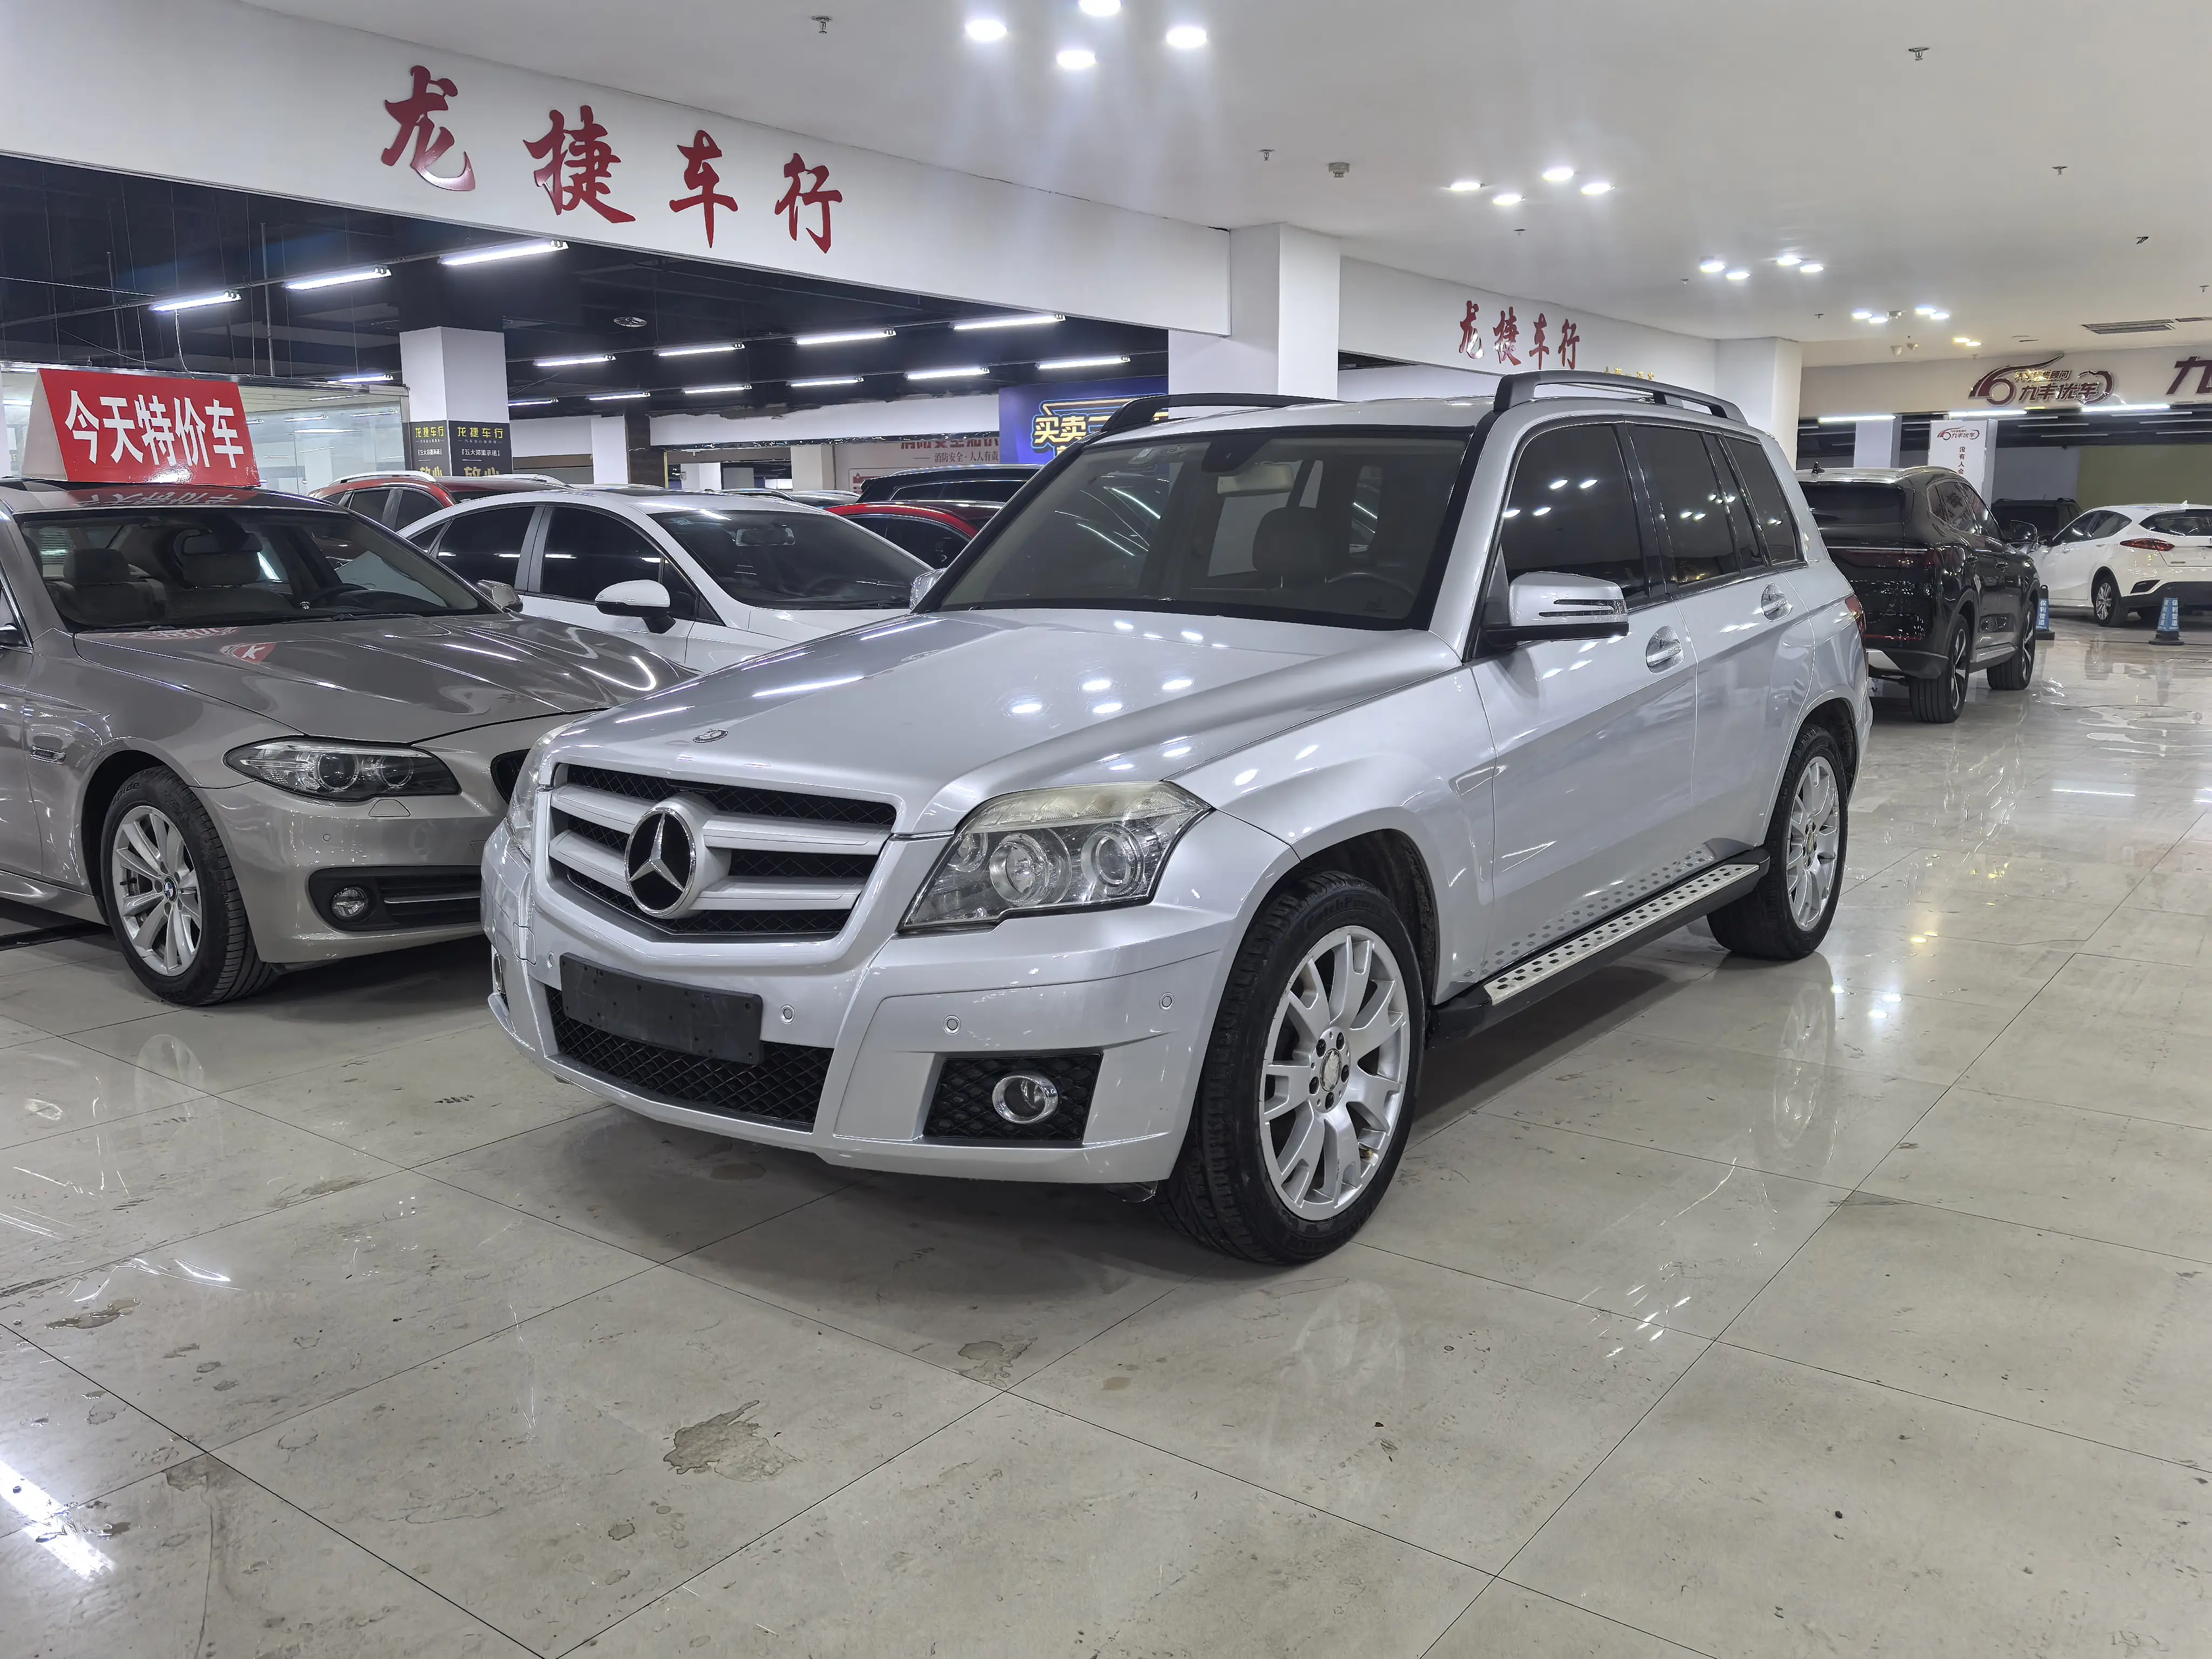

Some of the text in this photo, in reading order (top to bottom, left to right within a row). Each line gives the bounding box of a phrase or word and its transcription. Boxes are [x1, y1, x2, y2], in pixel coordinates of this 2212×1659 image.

[381, 65, 842, 254] 龙捷车行
[1459, 300, 1580, 369] 龙捷车行
[2019, 381, 2099, 402] 九丰优车
[65, 390, 244, 468] 今天特价车
[415, 426, 445, 438] 龙捷车行
[457, 426, 503, 439] 龙捷车行
